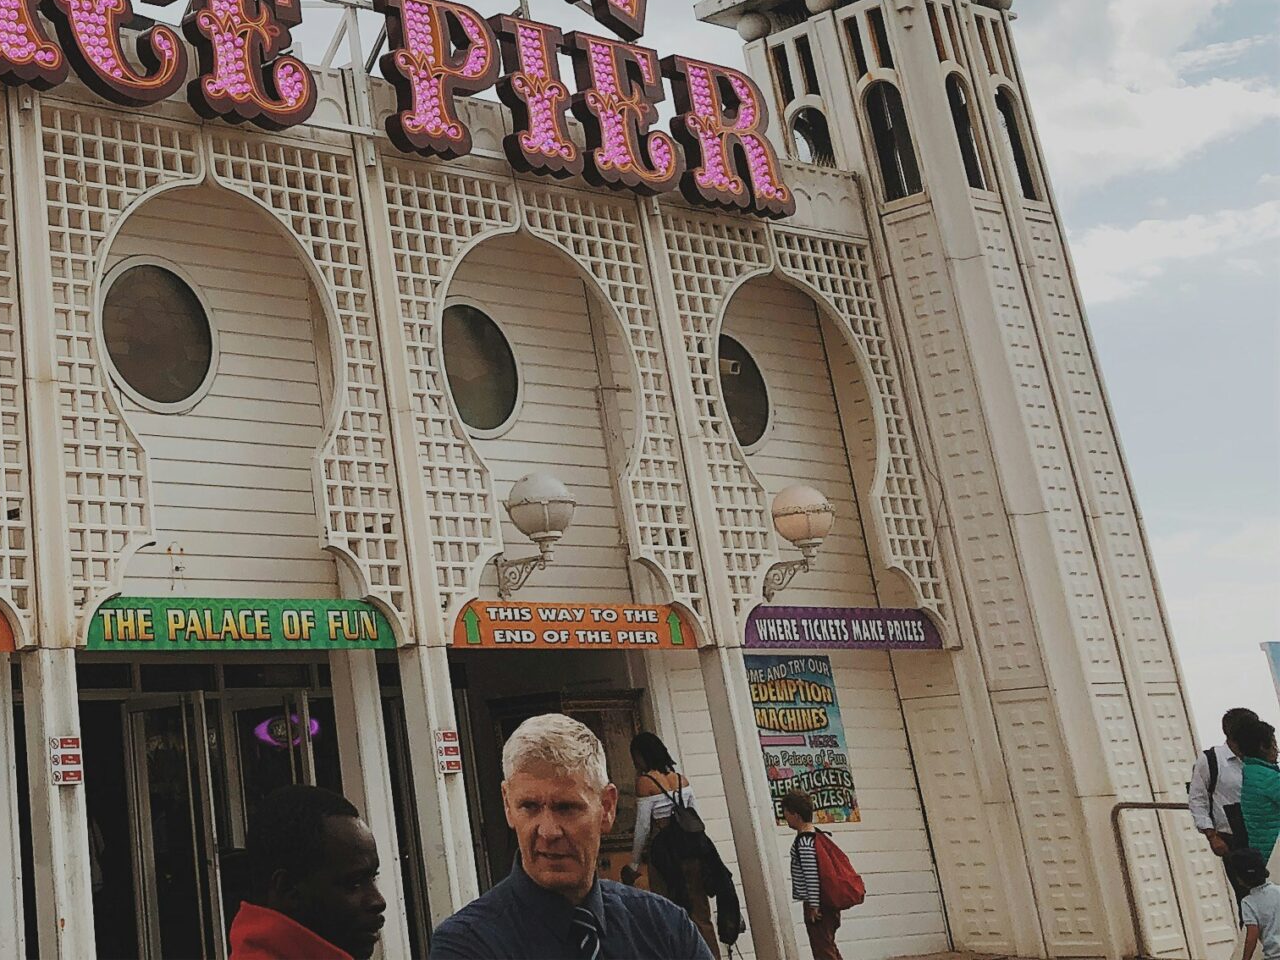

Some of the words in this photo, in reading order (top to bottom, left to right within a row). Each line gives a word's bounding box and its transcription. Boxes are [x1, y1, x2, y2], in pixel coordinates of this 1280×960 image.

[98, 608, 154, 640] THE
[167, 609, 271, 640] PALACE
[282, 609, 316, 640] OF
[327, 610, 377, 640] FUN
[486, 607, 532, 621] THIS
[538, 607, 585, 622] WAY
[590, 608, 618, 622] TO
[623, 609, 659, 623] THE
[493, 630, 536, 644] END
[543, 630, 570, 644] OF
[575, 630, 611, 644] THE
[618, 631, 659, 644] PIER
[756, 619, 799, 641] WHERE
[801, 619, 849, 641] TICKETS
[852, 619, 885, 641] MAKE
[887, 620, 926, 642] PRIZES
[747, 669, 765, 683] ME
[767, 663, 787, 681] AND
[788, 658, 806, 674] TRY
[808, 658, 830, 676] OUR
[750, 678, 833, 703] EDEMPTION
[754, 707, 828, 732] MACHINES
[763, 751, 780, 766] the
[780, 750, 814, 766] Palace
[815, 749, 826, 766] of
[826, 749, 848, 765] Fun
[769, 776, 800, 797] HERE
[801, 769, 852, 791] TICKETS
[812, 790, 845, 810] RIZES
